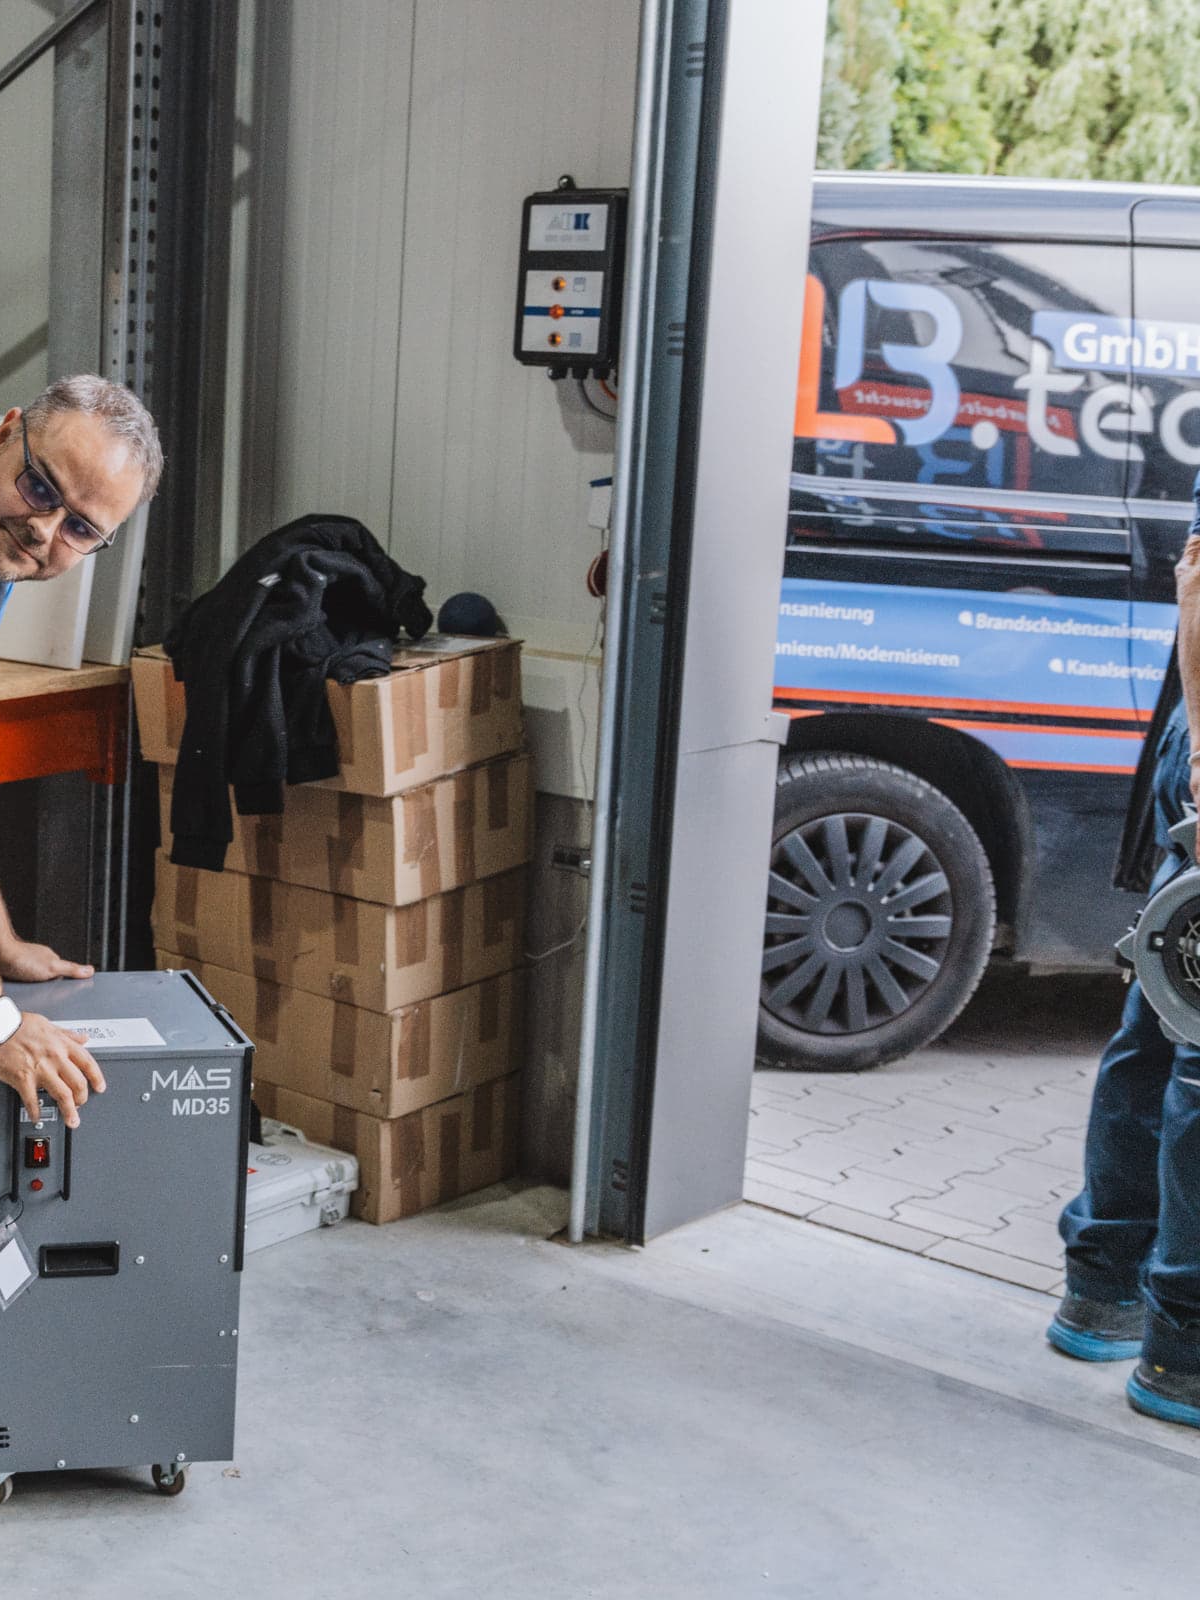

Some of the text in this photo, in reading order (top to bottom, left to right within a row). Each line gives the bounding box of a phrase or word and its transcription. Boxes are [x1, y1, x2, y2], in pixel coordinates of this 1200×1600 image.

[1063, 322, 1200, 371] GmbH
[975, 613, 1176, 646] Brandschadensanierung
[152, 1065, 232, 1091] MAS
[172, 1097, 231, 1116] MD35
